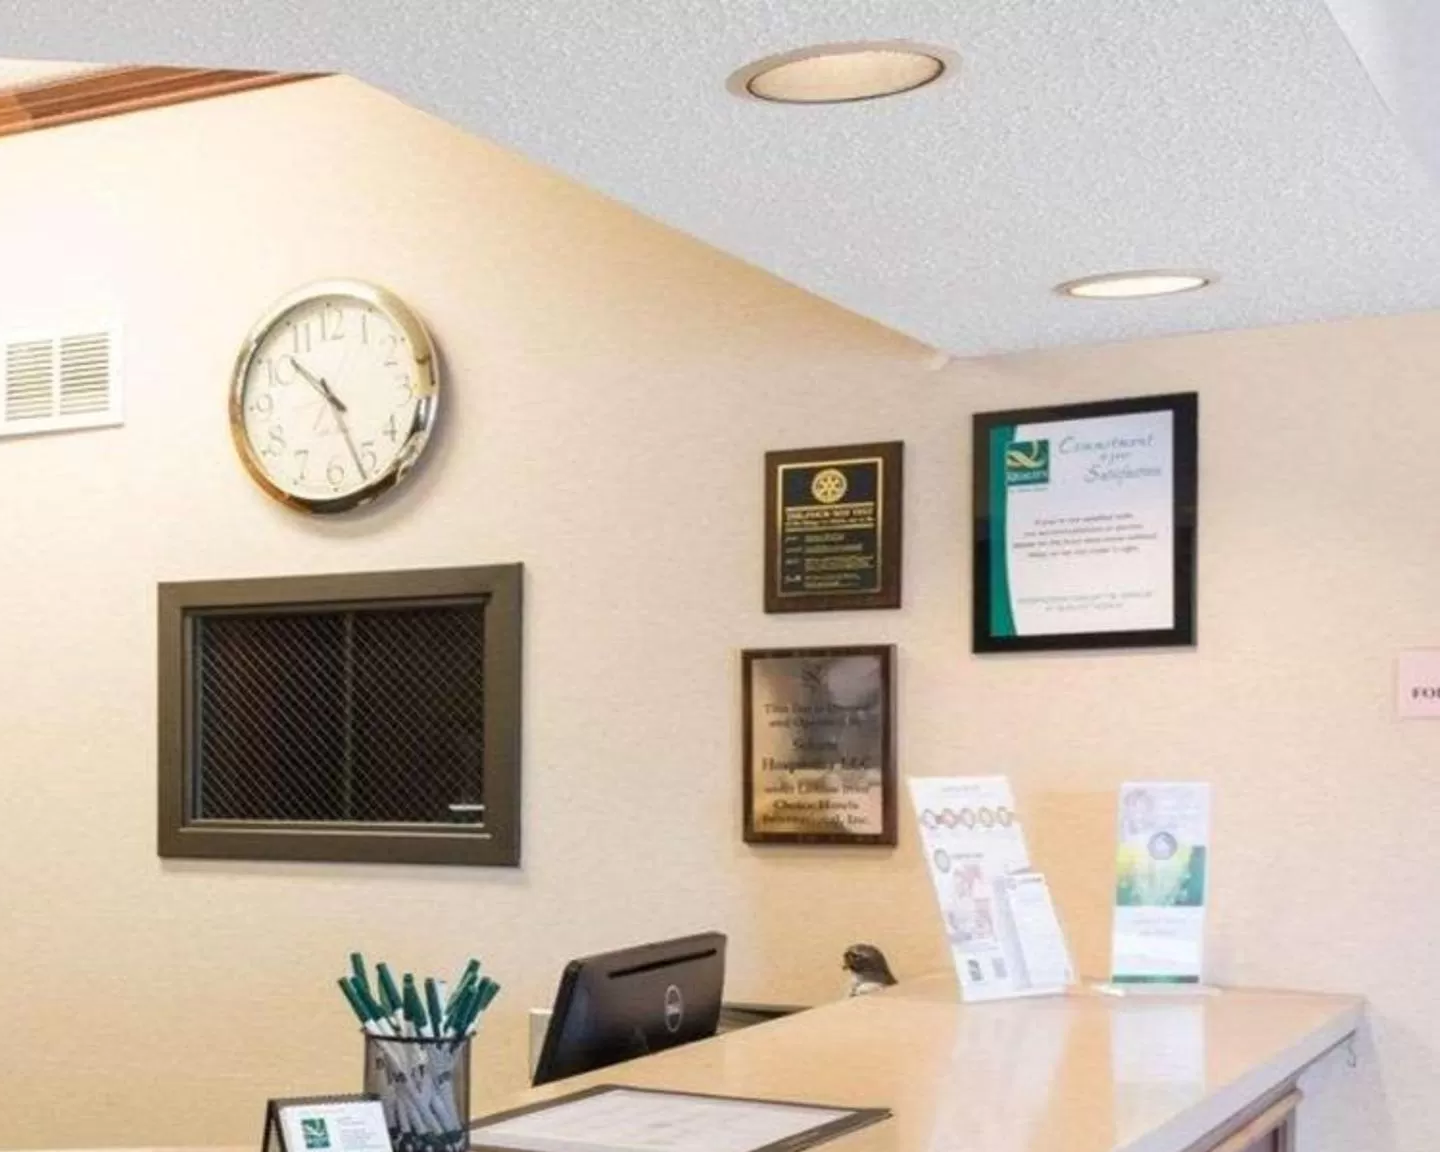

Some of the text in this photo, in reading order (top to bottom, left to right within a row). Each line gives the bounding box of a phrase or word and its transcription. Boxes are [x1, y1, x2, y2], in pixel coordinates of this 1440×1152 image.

[293, 321, 311, 352] 11
[320, 308, 345, 341] 12
[266, 353, 296, 387] 10
[256, 393, 274, 425] 9
[382, 414, 398, 443] 4
[294, 449, 309, 480] 7
[326, 454, 345, 486] 6
